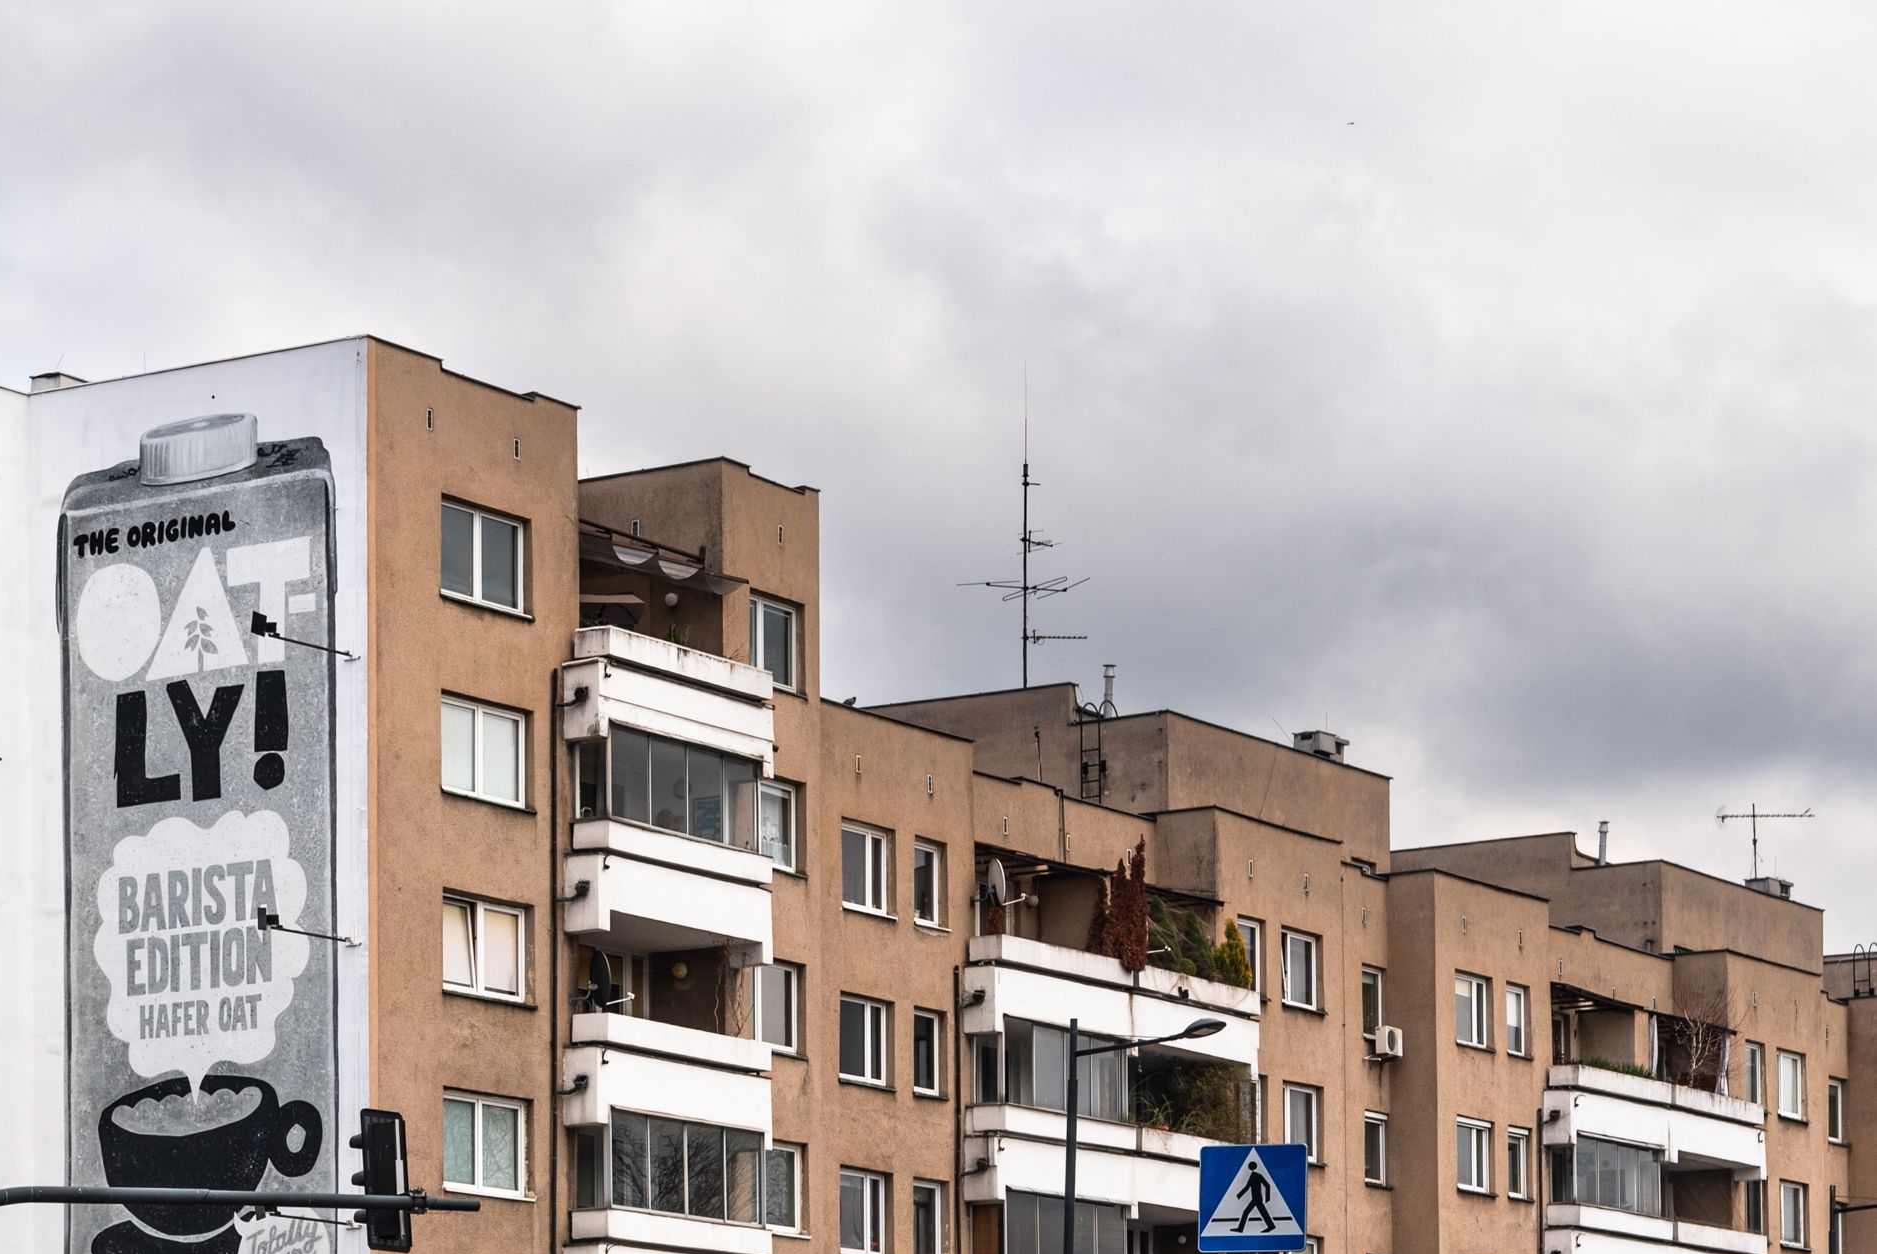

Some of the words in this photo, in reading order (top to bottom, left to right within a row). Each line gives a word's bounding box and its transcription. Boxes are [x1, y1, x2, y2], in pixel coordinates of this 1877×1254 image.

[73, 527, 119, 559] THE
[127, 510, 236, 549] ORIGINAL
[114, 670, 289, 808] LY!
[118, 858, 279, 934] BARISTA
[126, 925, 272, 997] EDITION
[139, 1000, 209, 1039] HAFER
[218, 993, 262, 1032] OAT
